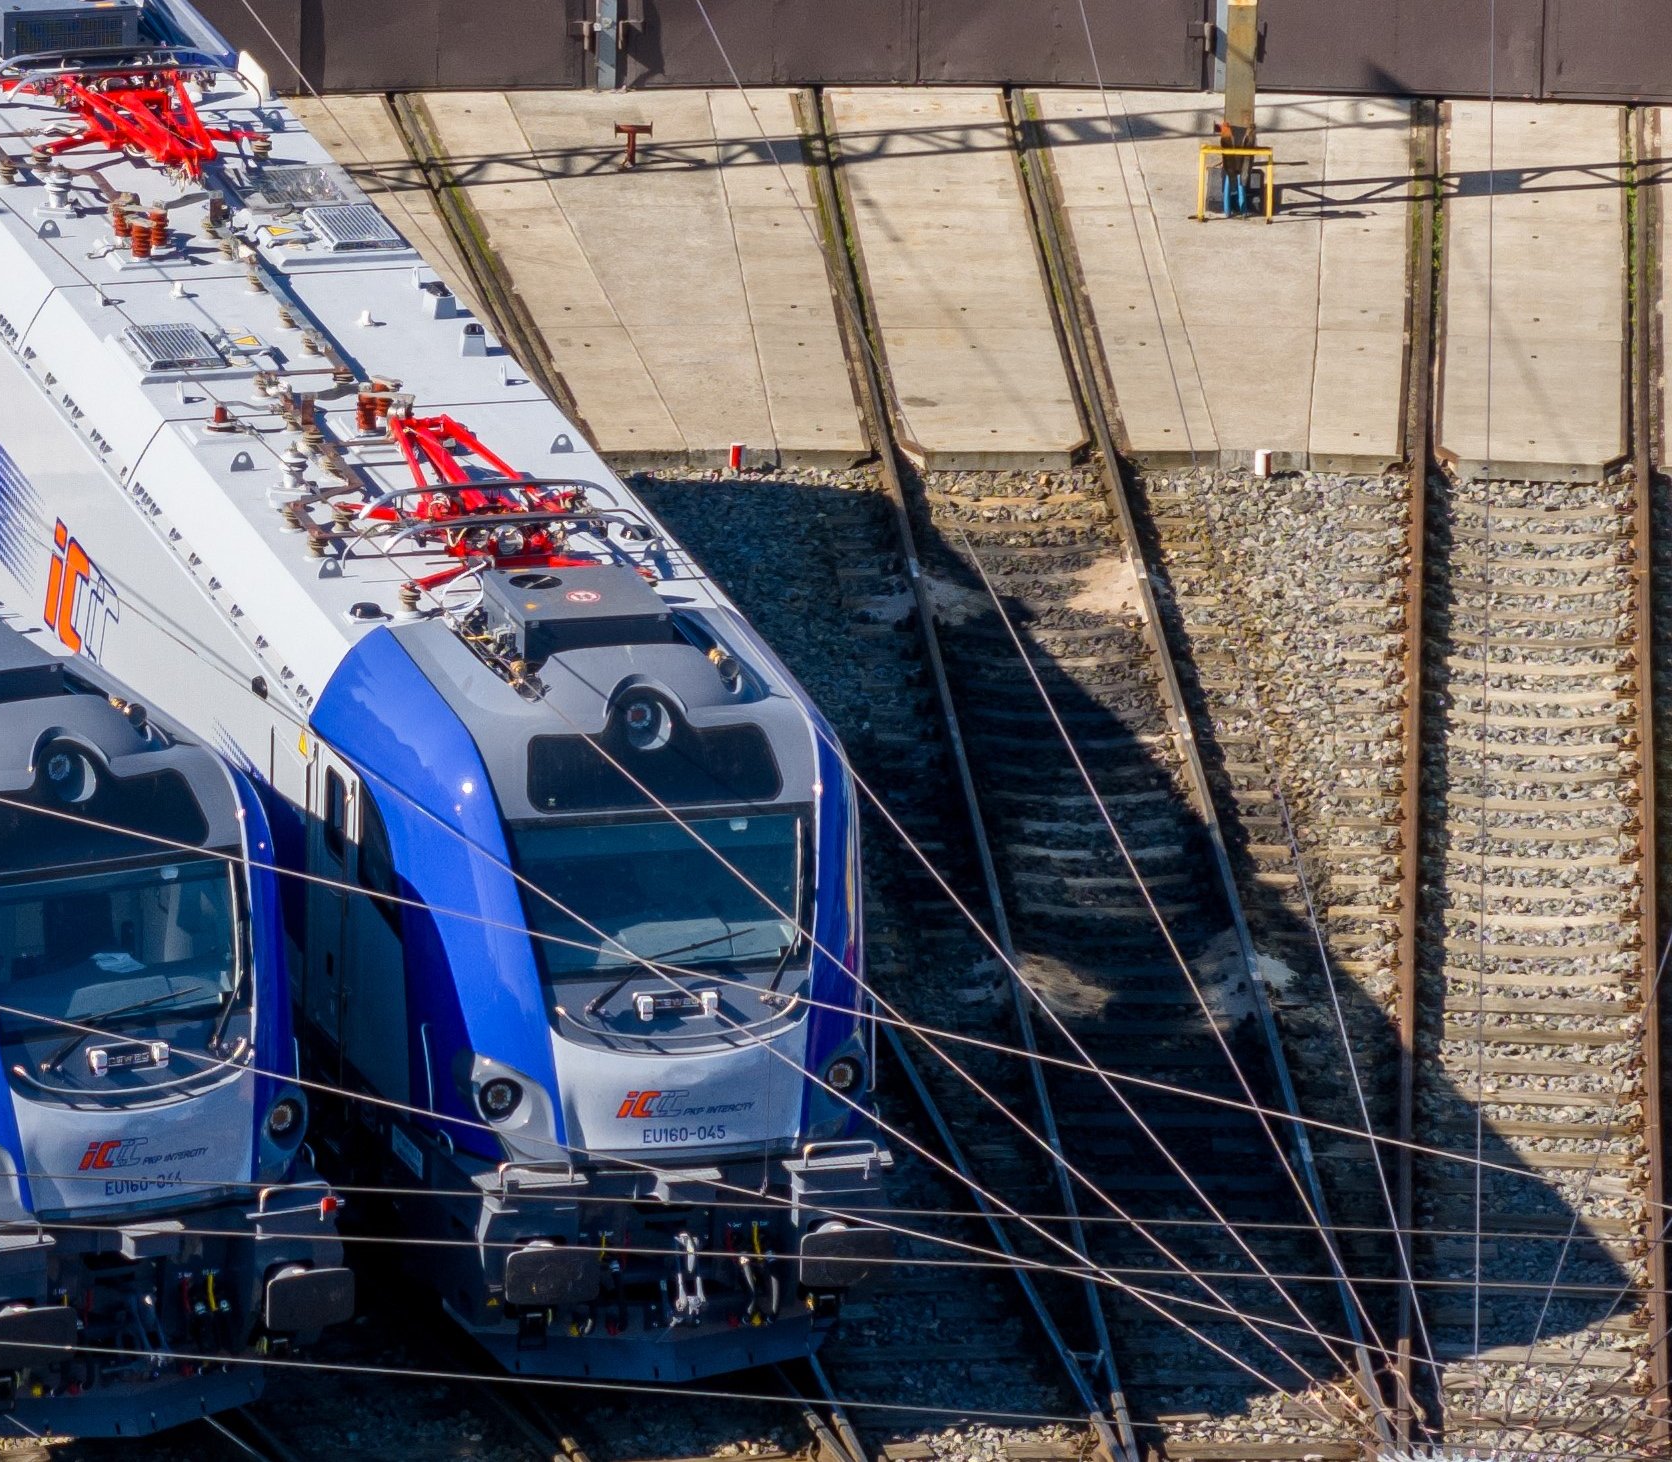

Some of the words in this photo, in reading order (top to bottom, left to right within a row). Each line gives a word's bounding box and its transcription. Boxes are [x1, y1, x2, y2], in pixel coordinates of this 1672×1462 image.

[682, 1106, 705, 1116] PKP
[706, 1101, 755, 1114] INTERCITY
[643, 1124, 726, 1144] EU160-045
[142, 1155, 162, 1165] PKP
[164, 1147, 208, 1162] INTERCITY
